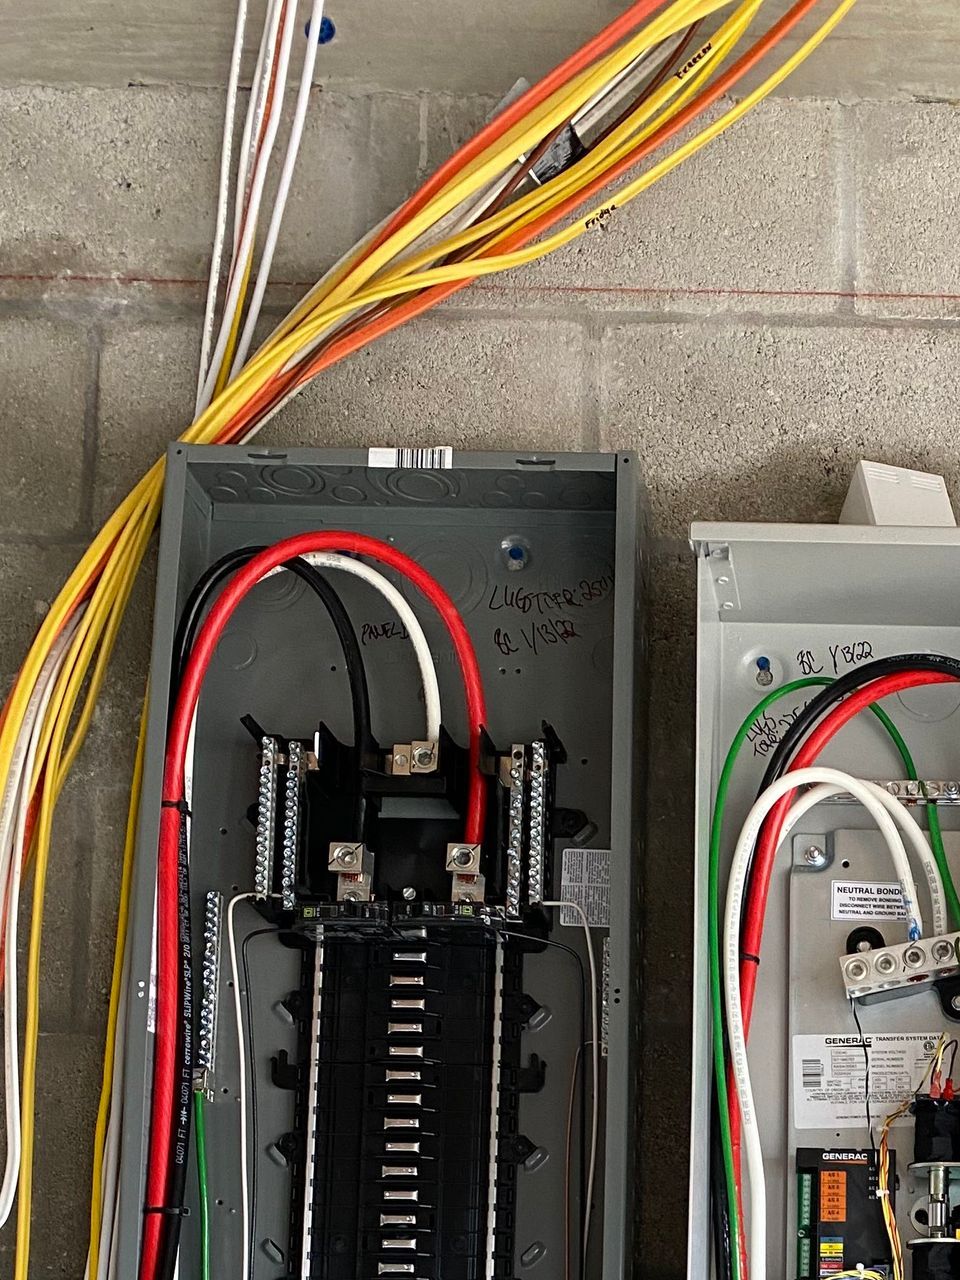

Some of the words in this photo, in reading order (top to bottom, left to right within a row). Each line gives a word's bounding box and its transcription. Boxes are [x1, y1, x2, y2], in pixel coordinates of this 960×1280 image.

[837, 886, 875, 895] NEUTRAL
[825, 1036, 872, 1045] GENERAC
[822, 1152, 868, 1161] GENERAC
